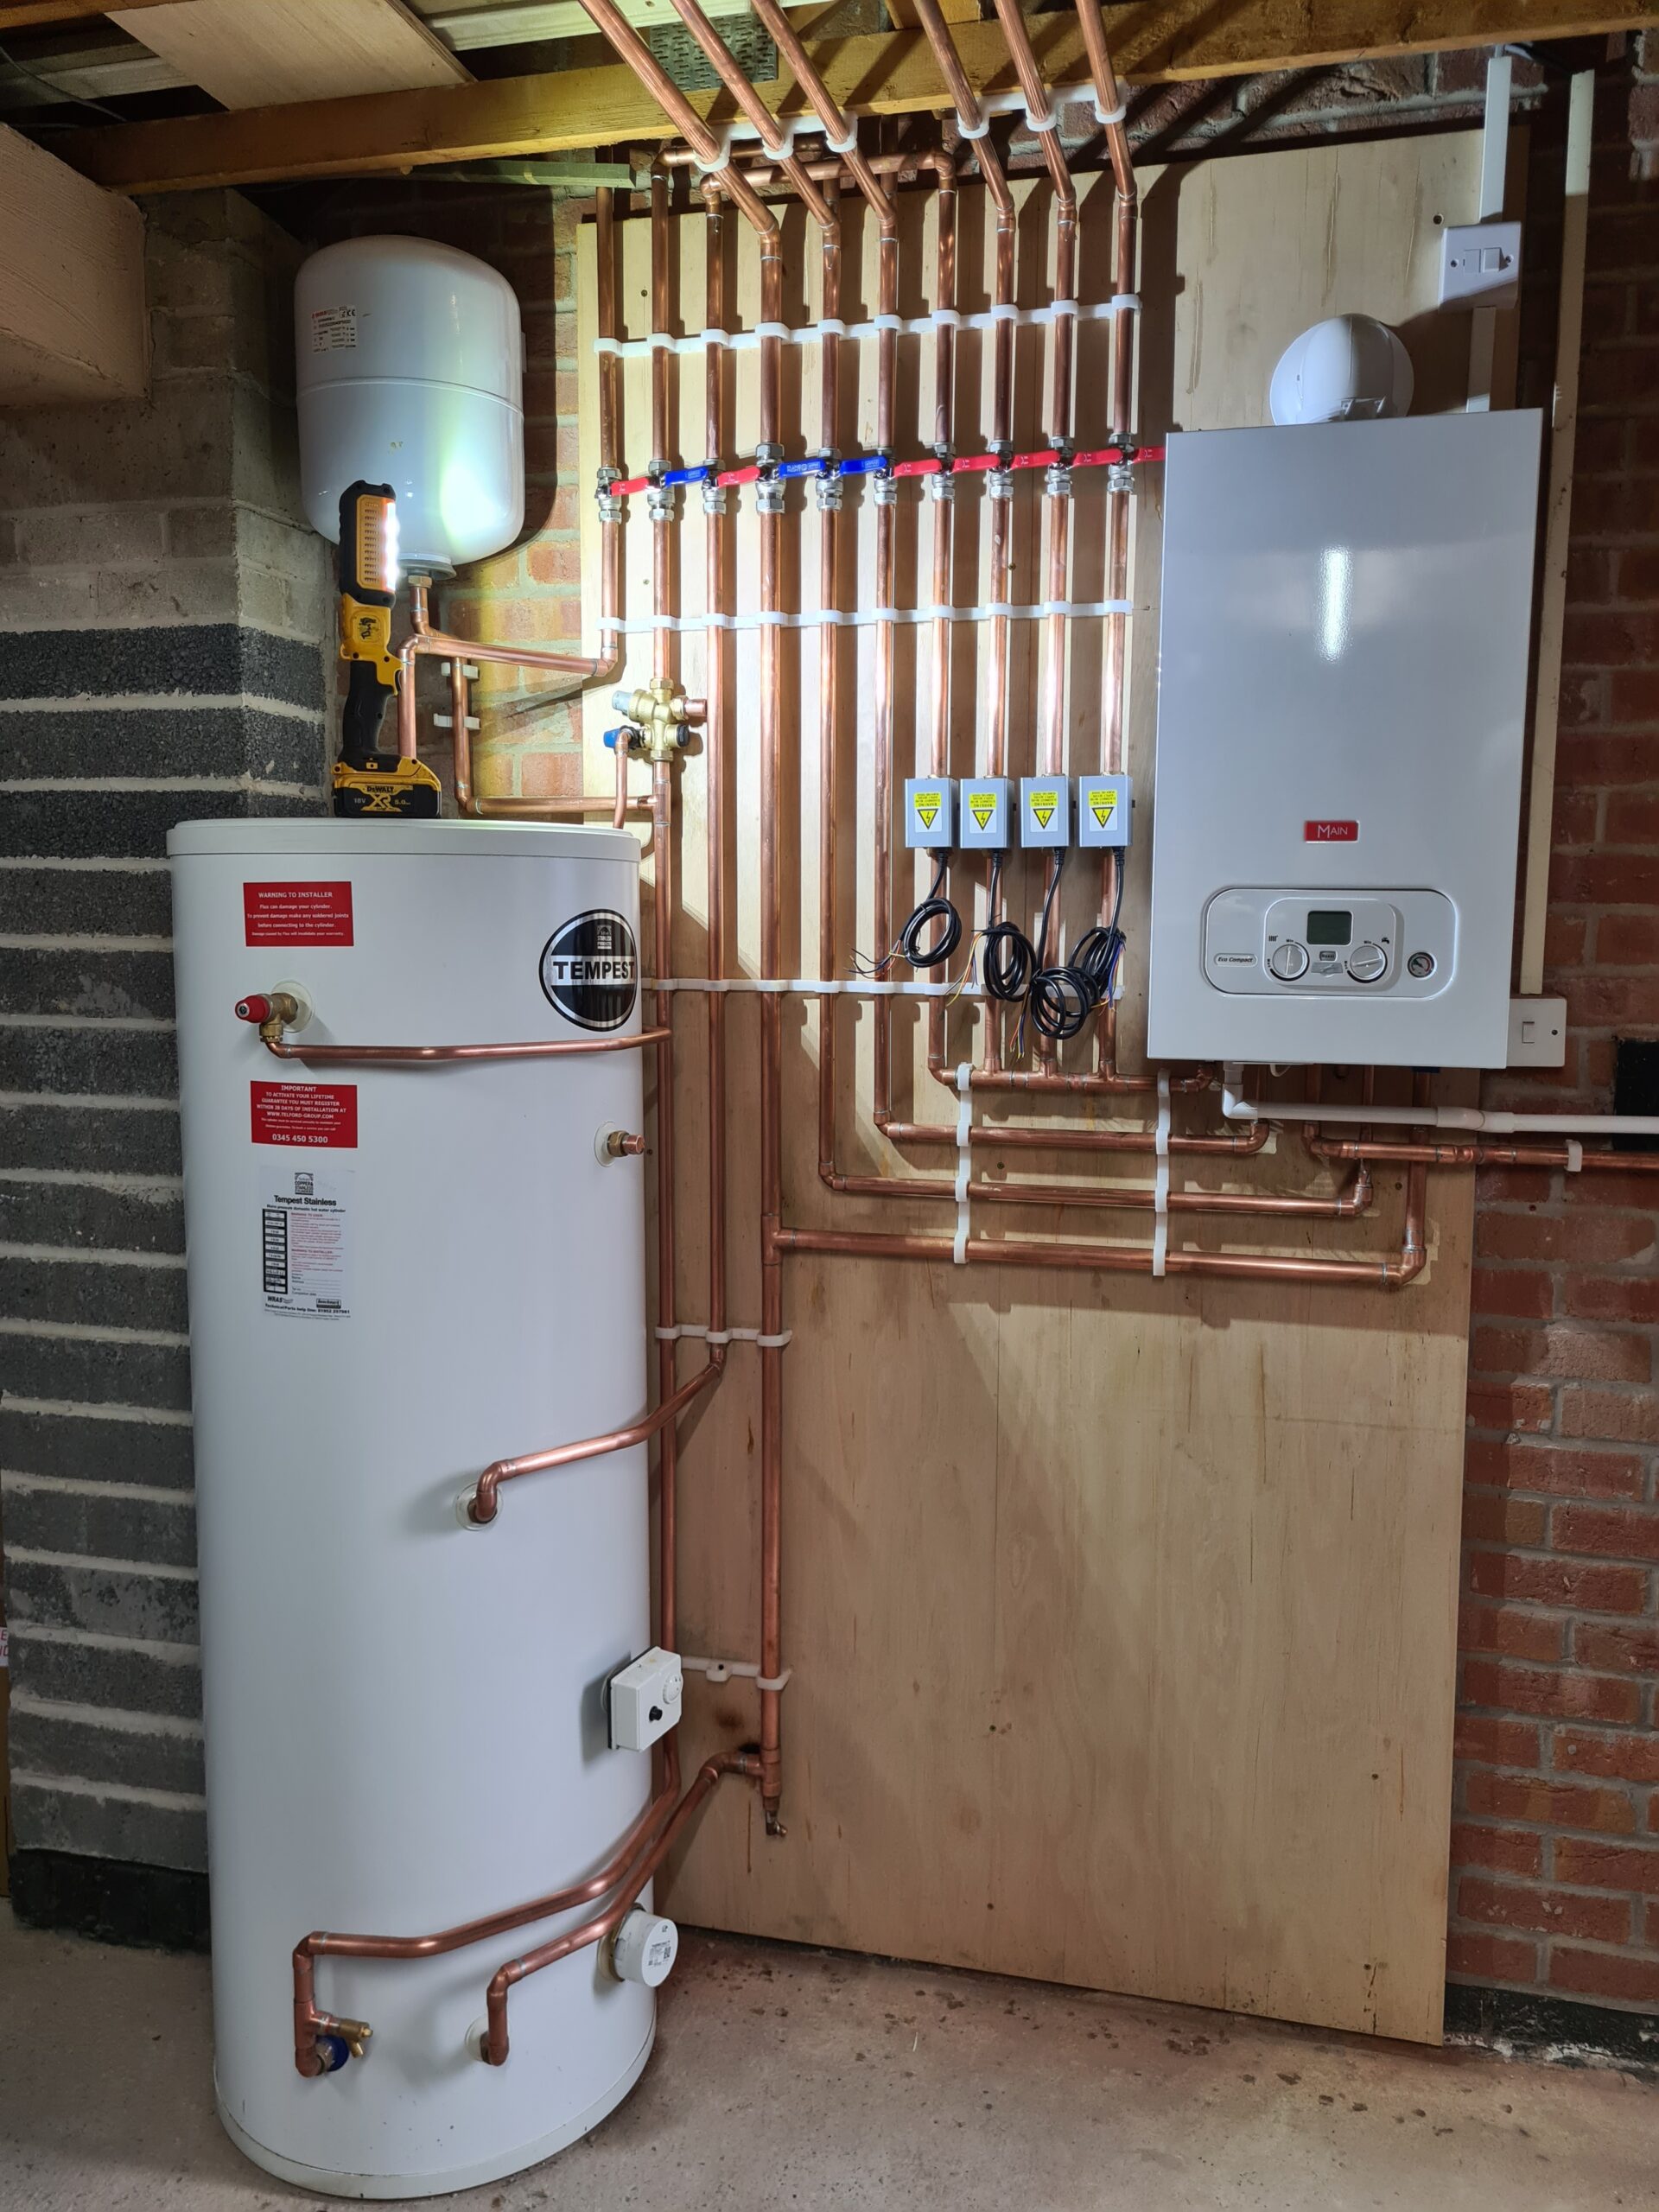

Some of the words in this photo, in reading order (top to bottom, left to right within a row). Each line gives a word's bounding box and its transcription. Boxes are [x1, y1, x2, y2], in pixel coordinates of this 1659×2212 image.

[1318, 824, 1348, 838] MAIN
[553, 961, 635, 980] TEMPEST
[274, 1195, 303, 1205] Tempest
[304, 1197, 337, 1206] Stainless
